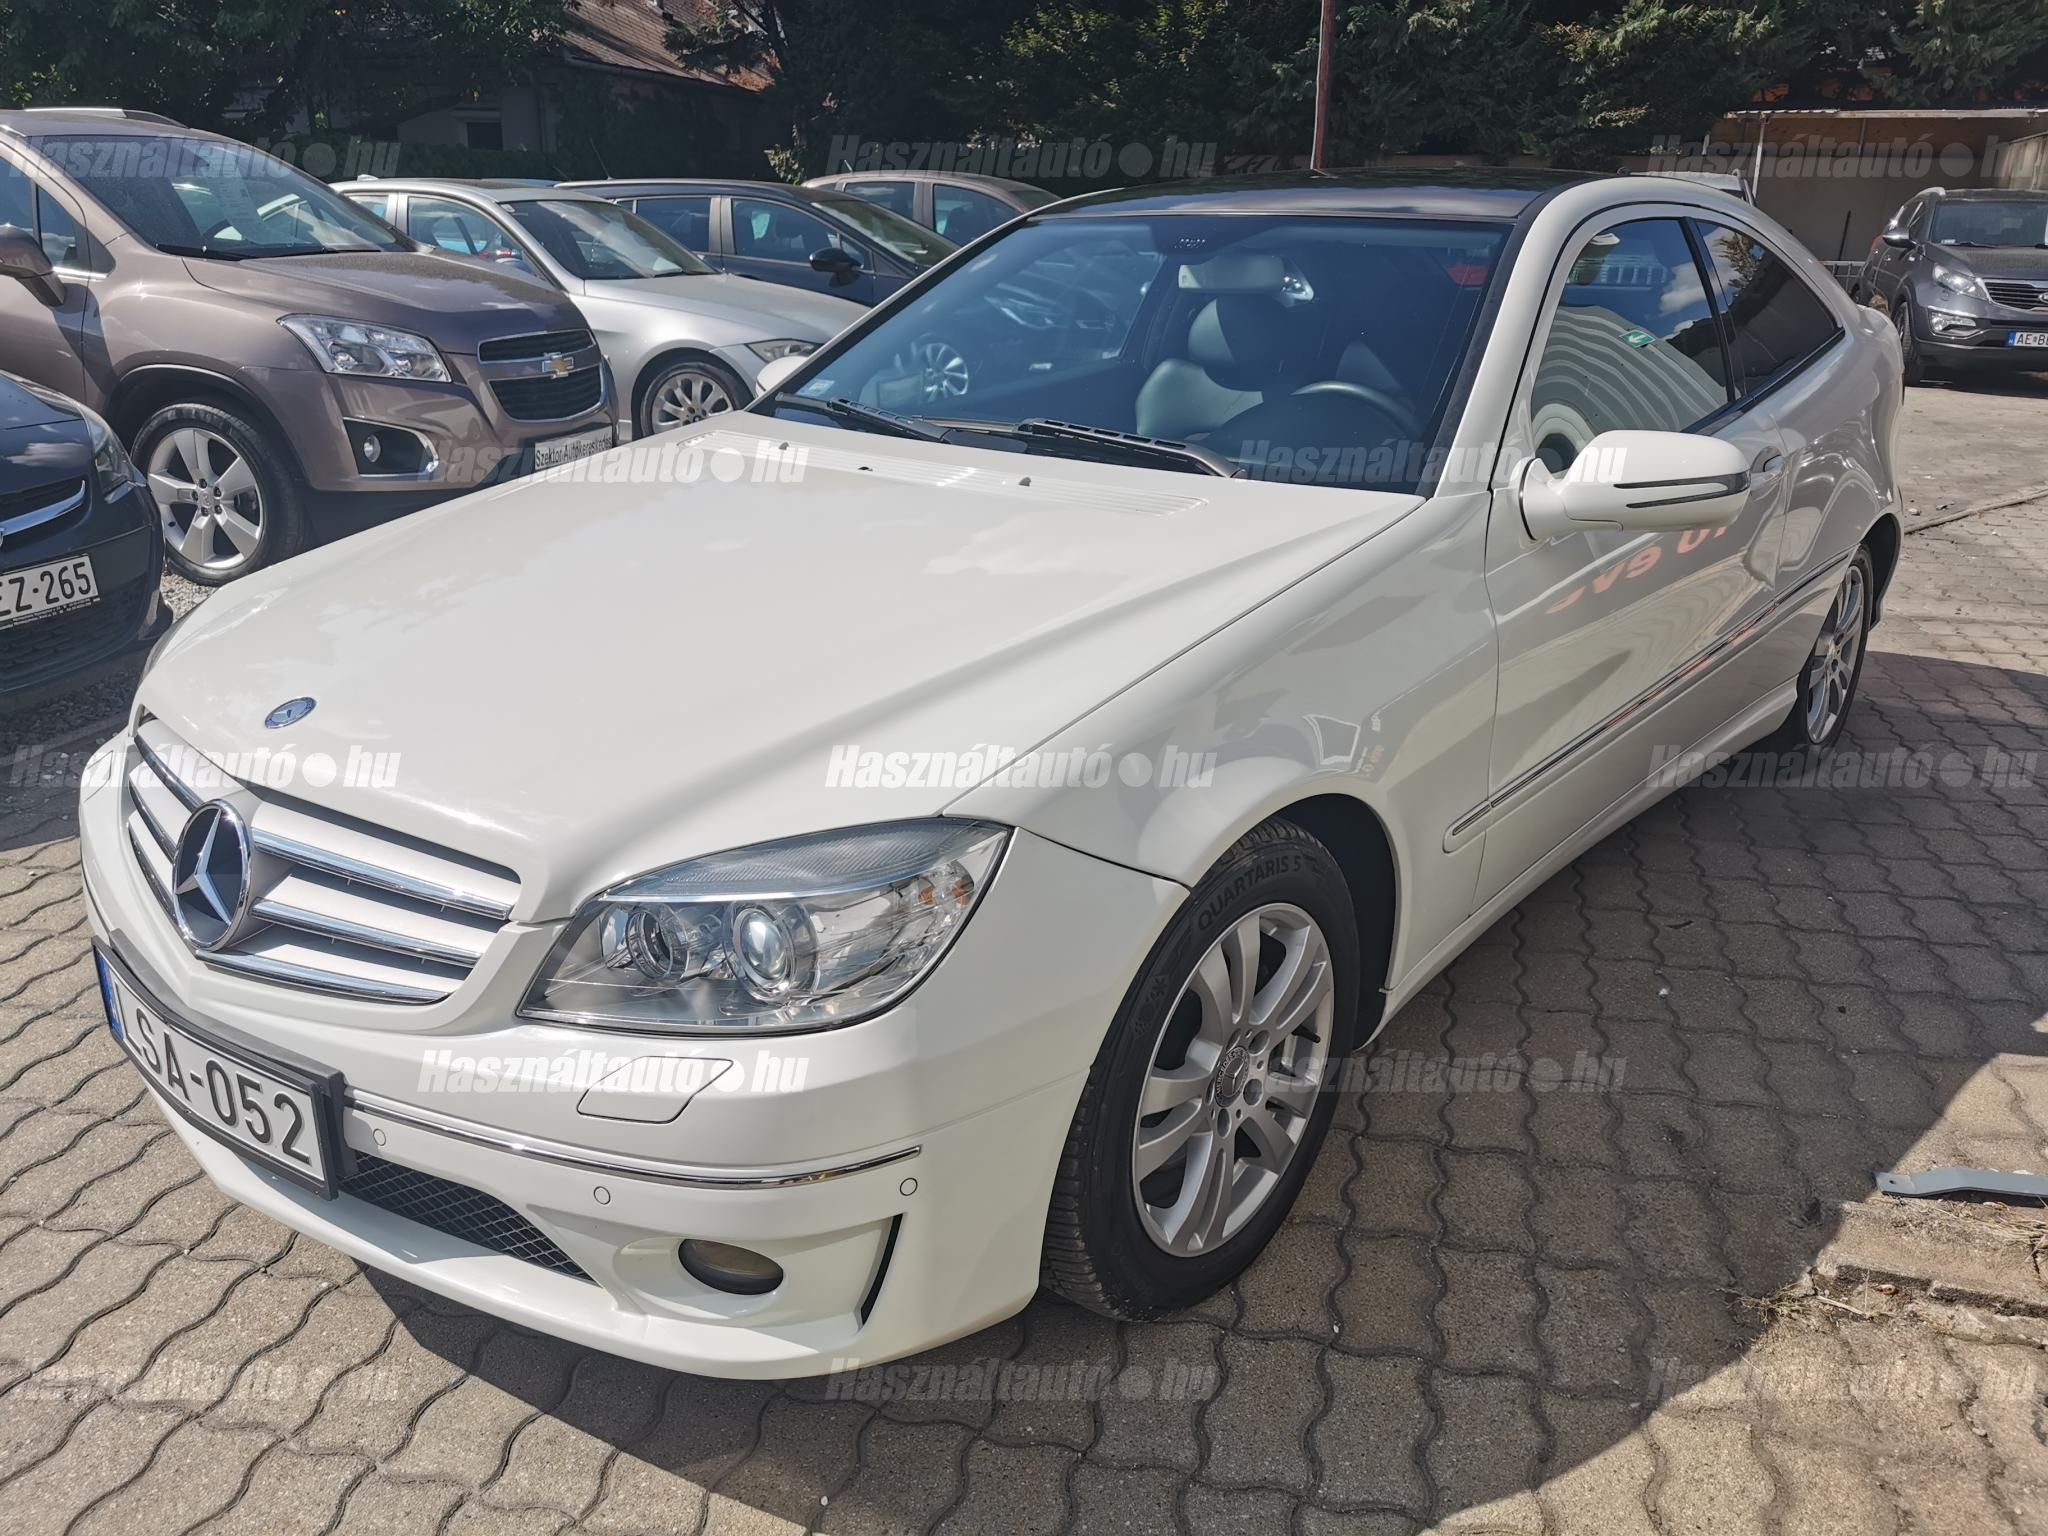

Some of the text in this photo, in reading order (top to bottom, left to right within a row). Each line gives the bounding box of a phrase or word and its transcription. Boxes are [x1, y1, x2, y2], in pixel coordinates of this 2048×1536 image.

[536, 447, 562, 468] Szektor
[1199, 855, 1289, 931] QUARTARIS
[114, 982, 311, 1166] LSA-052
